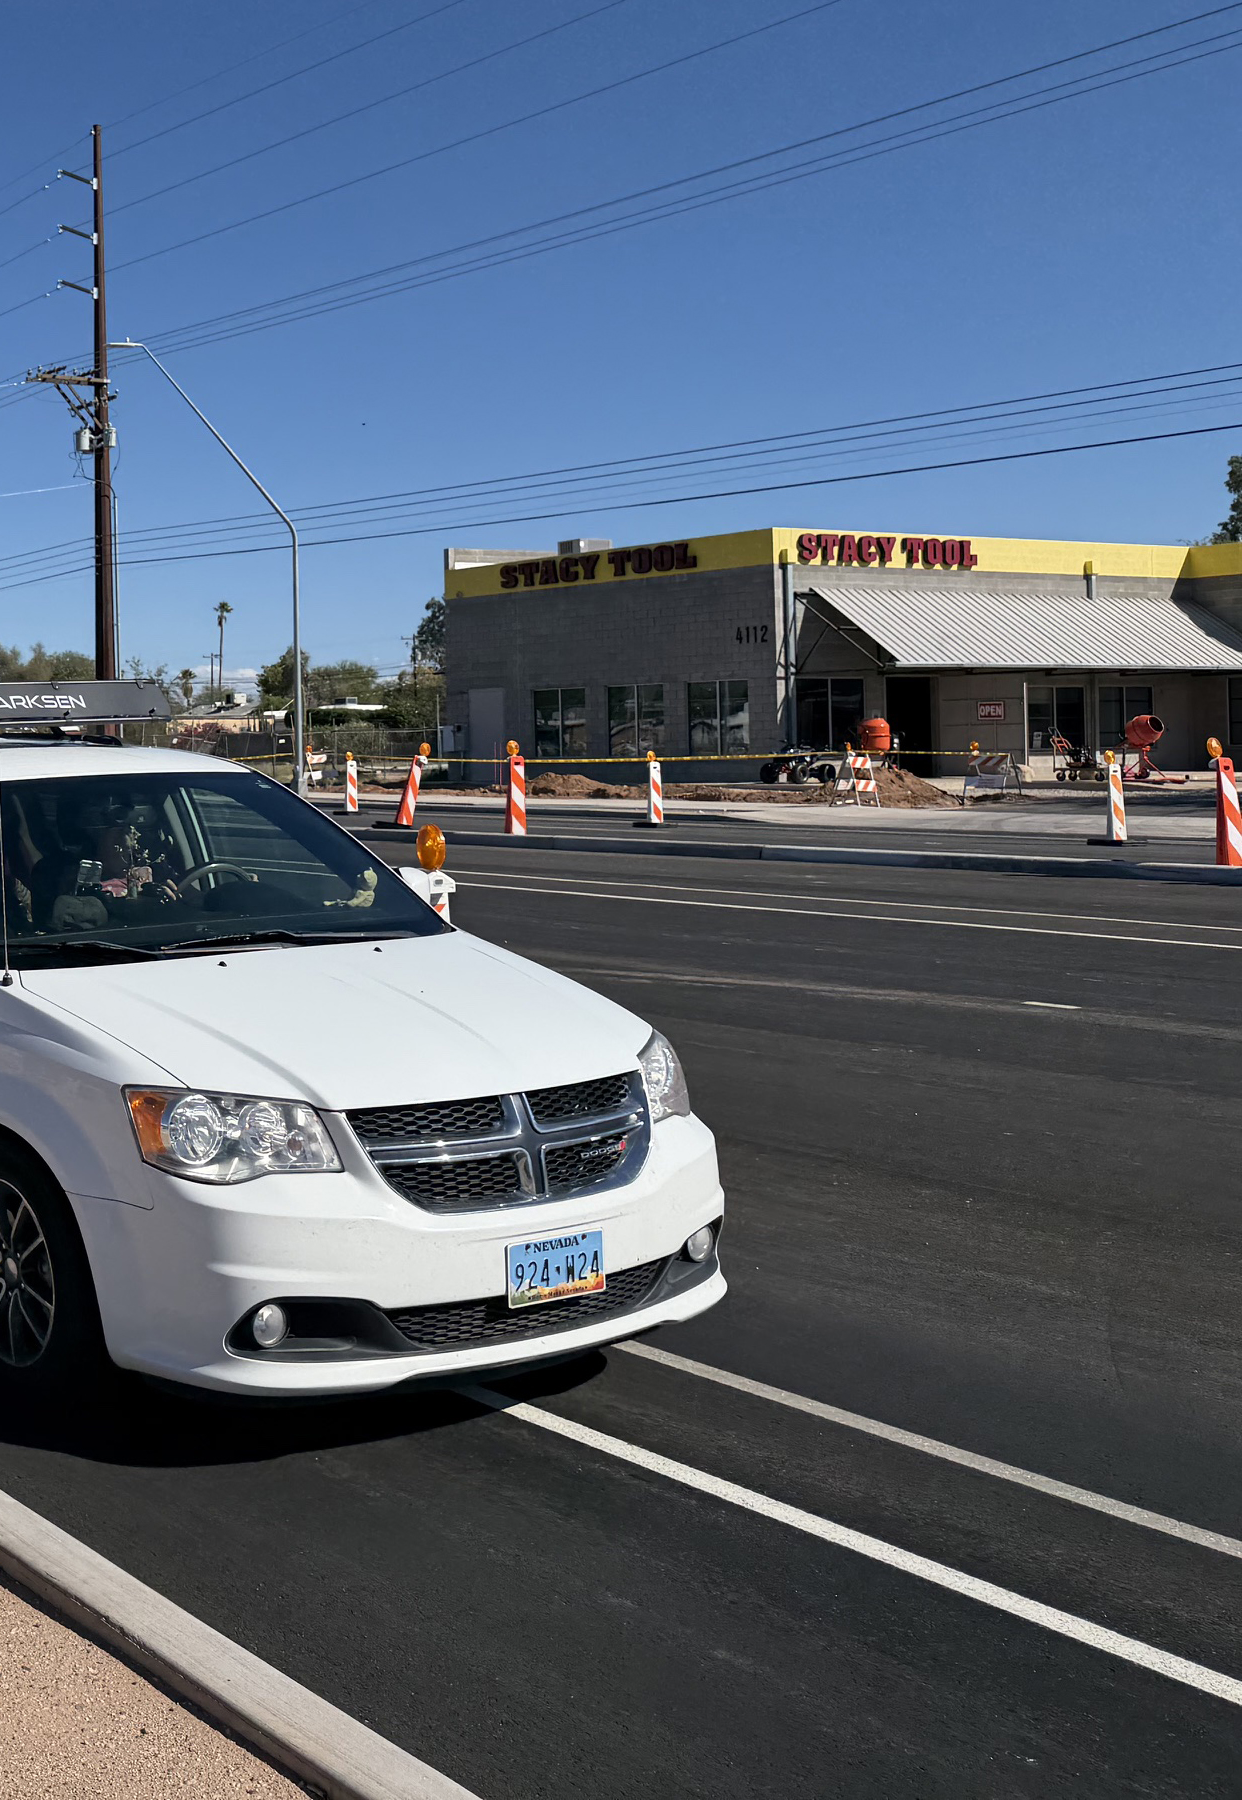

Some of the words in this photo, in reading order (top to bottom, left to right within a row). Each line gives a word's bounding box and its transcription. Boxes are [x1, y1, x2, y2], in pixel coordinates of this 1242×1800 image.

[797, 533, 896, 565] STACY
[901, 537, 978, 568] TOOL
[499, 554, 600, 589] STACY
[607, 542, 697, 577] TOOL
[736, 624, 768, 644] 4112
[979, 704, 1002, 716] OPEN
[533, 1235, 580, 1254] NEVADA
[515, 1258, 550, 1292] 924
[565, 1250, 600, 1284] W24
